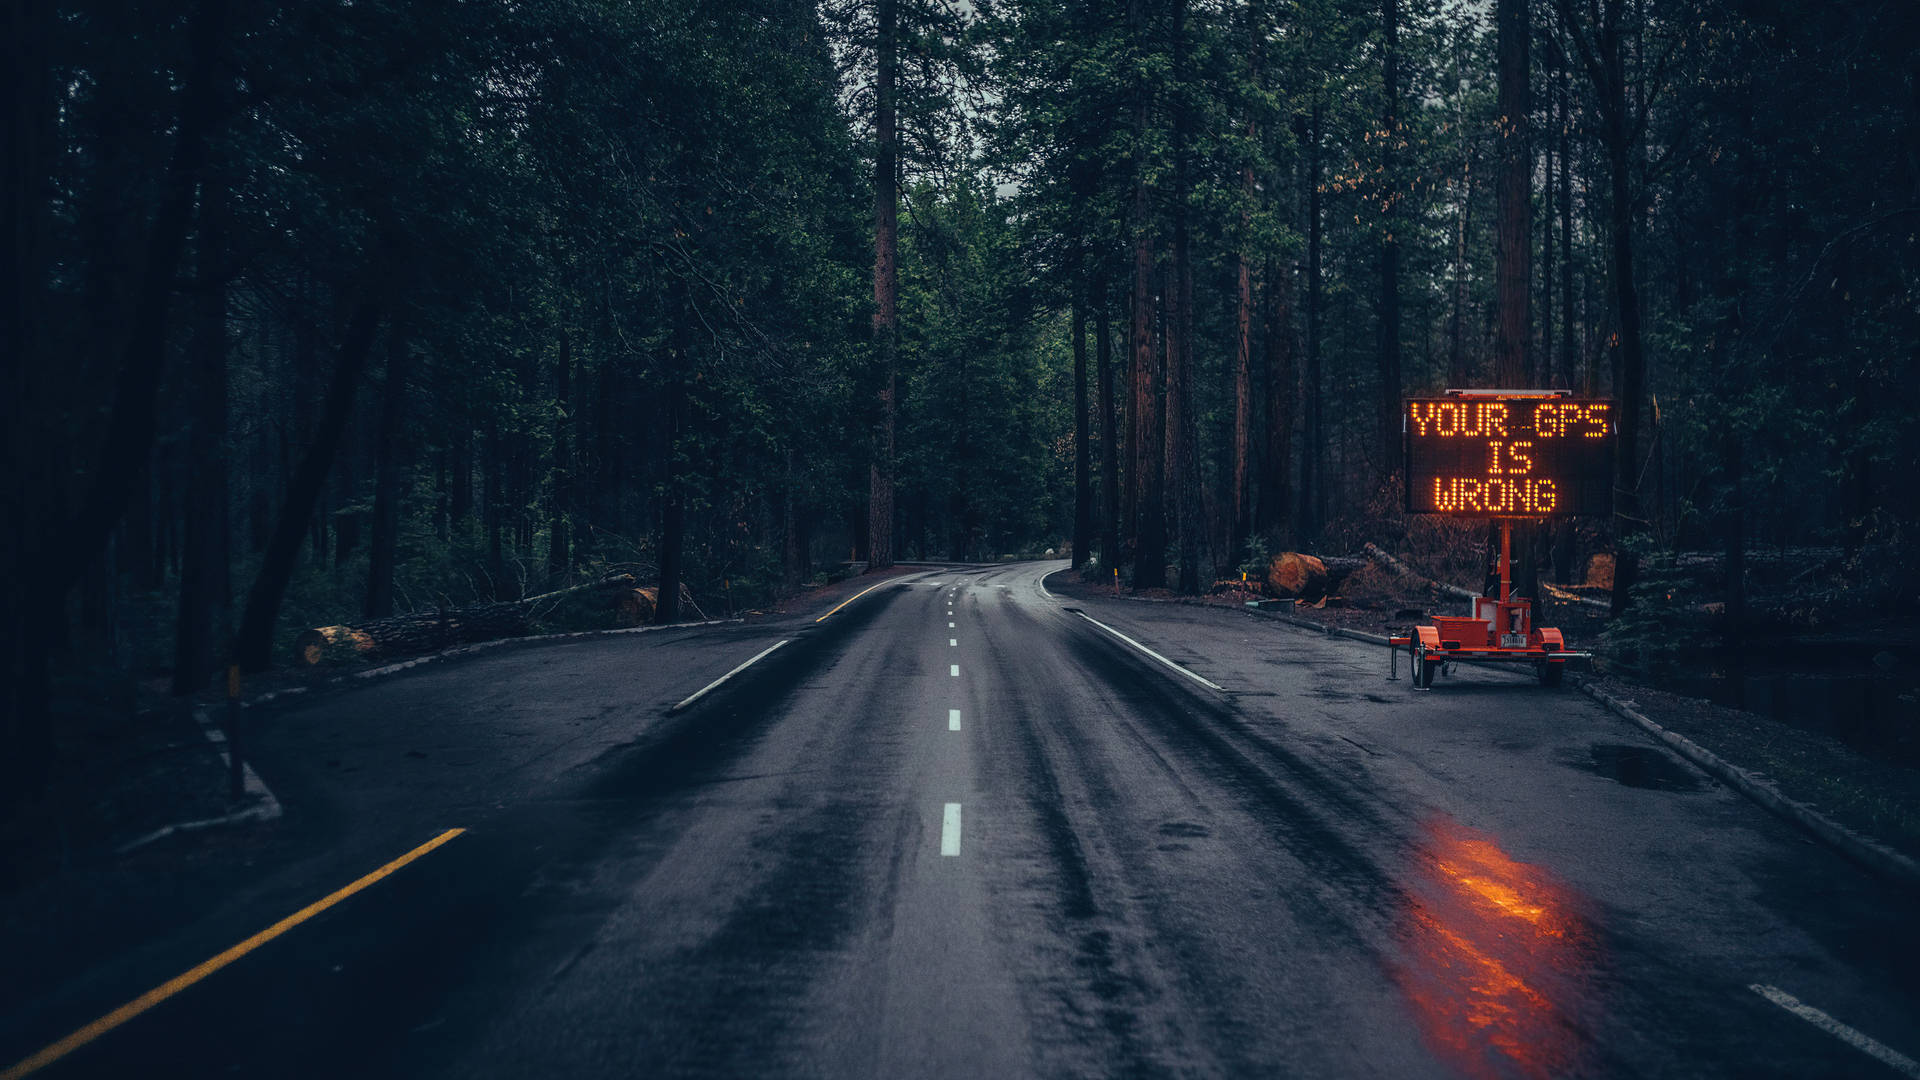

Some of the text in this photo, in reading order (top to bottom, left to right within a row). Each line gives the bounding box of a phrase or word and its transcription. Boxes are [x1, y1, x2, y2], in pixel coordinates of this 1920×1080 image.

[1410, 402, 1610, 438] YOUR GPS
[1487, 440, 1533, 475] IS
[1432, 477, 1557, 513] WRONG
